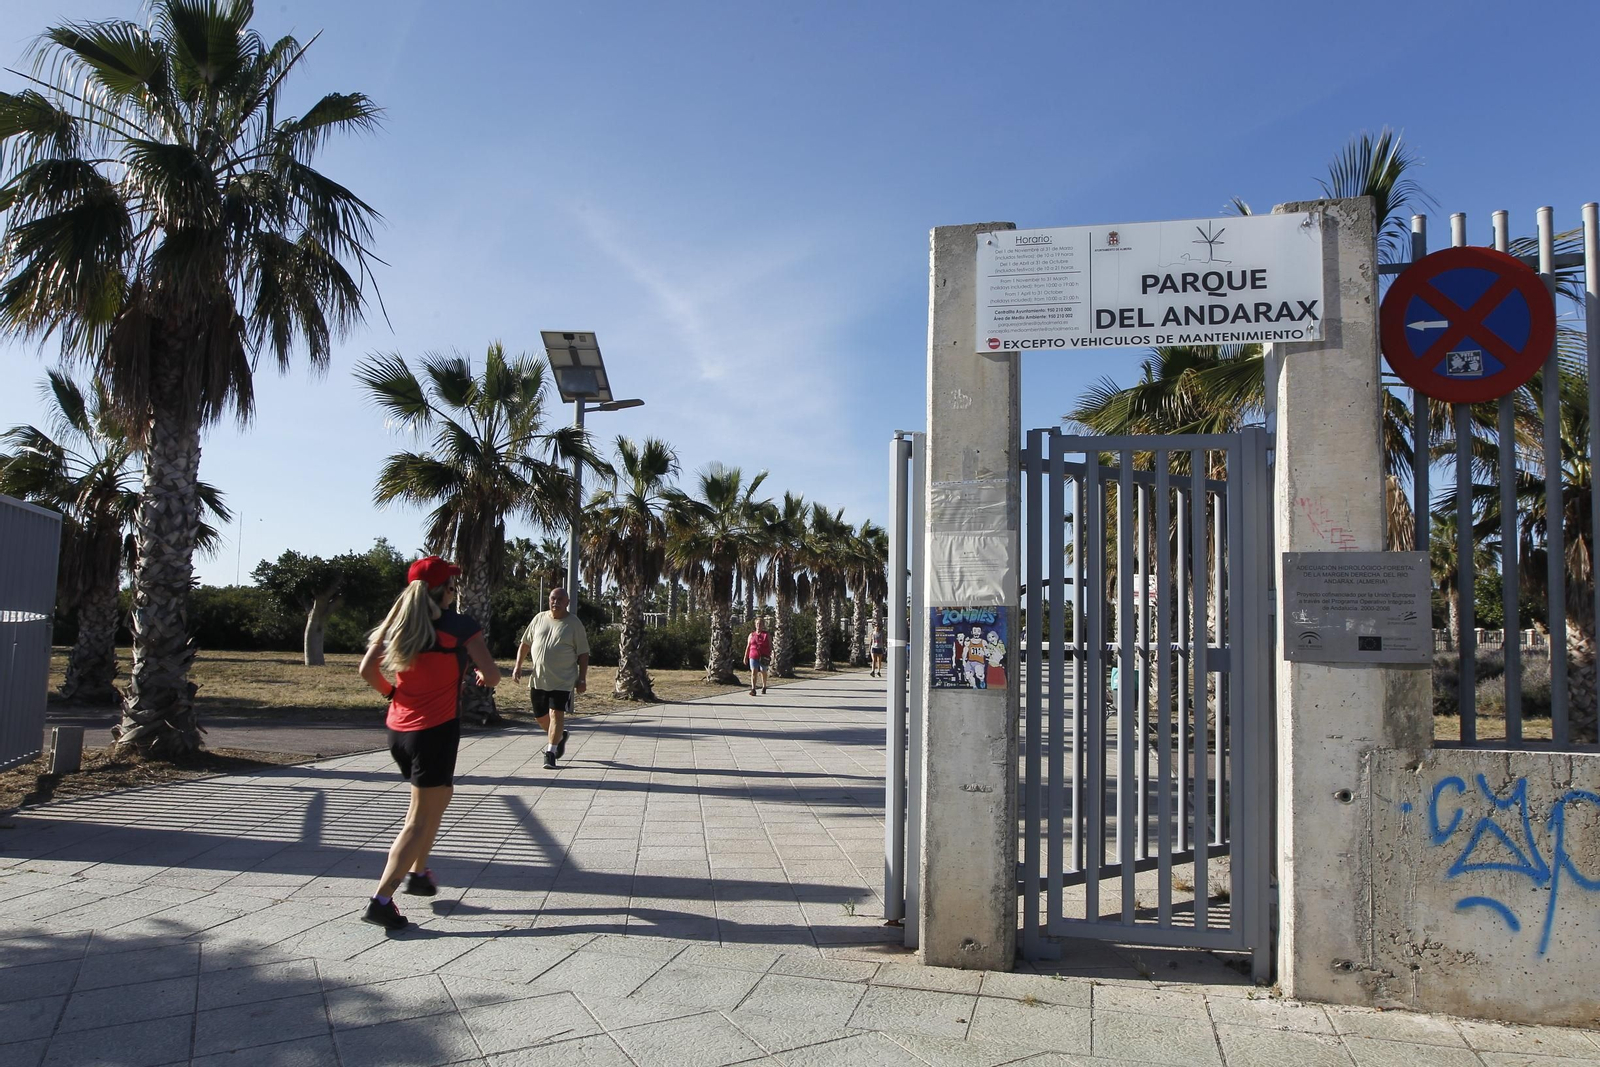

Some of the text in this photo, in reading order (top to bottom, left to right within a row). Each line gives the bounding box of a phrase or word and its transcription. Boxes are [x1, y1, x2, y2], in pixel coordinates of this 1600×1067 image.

[1016, 234, 1052, 243] Horario:
[1142, 269, 1268, 297] PARQUE
[1096, 300, 1319, 330] DEL ANDARAX
[1004, 329, 1304, 349] EXCEPTO VEHICULOS DE MANTENIMIENTO
[942, 609, 996, 626] ZOMBIES
